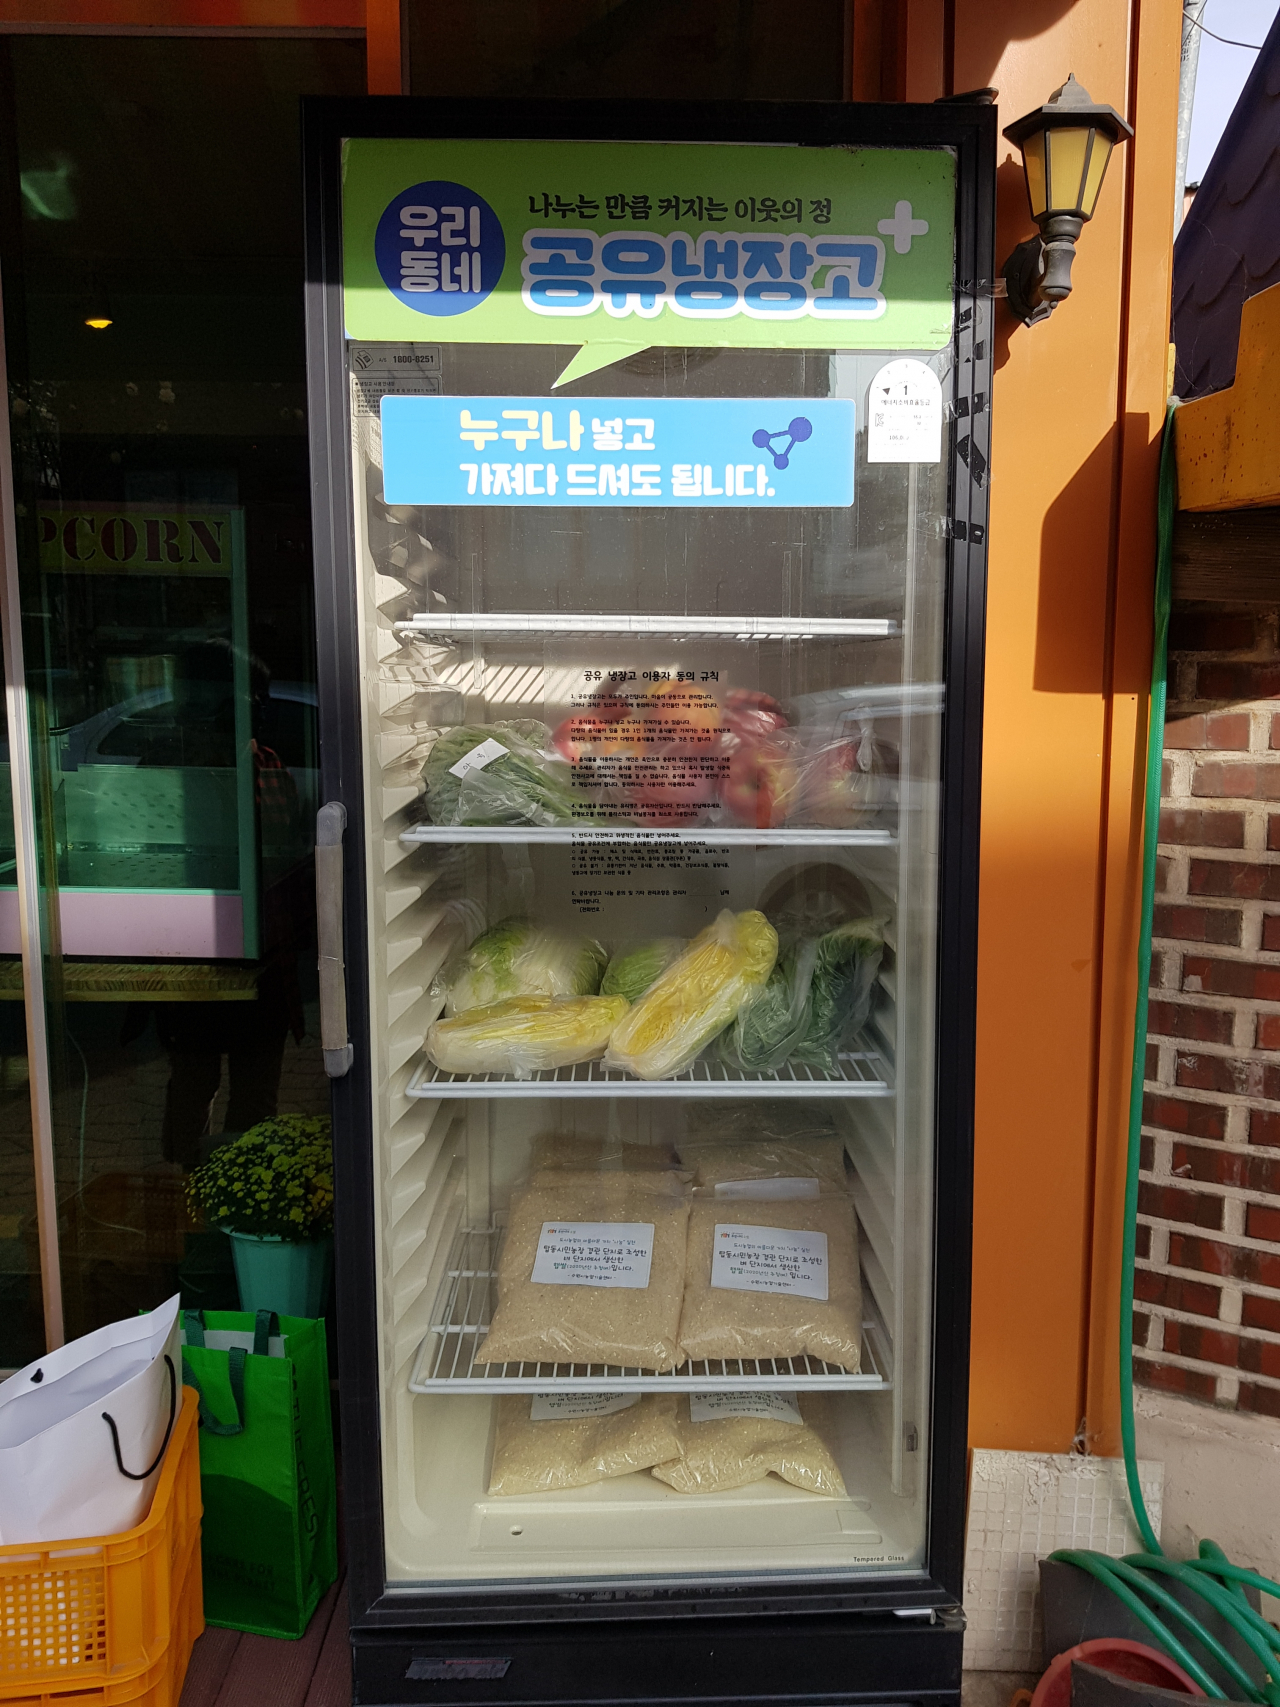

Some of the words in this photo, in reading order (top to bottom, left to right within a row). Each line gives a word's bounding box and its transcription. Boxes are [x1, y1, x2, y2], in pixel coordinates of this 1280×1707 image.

[528, 193, 601, 220] 나누는
[605, 194, 653, 222] 만큼
[657, 196, 729, 223] 커지는
[734, 197, 803, 224] 이웃의
[808, 197, 833, 225] 정
[399, 204, 481, 247] 우리
[399, 250, 482, 294] 동네
[525, 234, 882, 314] 공유냉장고
[393, 355, 434, 364] 1800-8251
[903, 384, 908, 396] 1
[458, 409, 582, 451] 누구나
[591, 416, 656, 452] 넣고
[460, 462, 559, 497] 가져다
[566, 464, 662, 497] 드셔도
[670, 463, 776, 498] 됩니다.
[584, 671, 602, 681] 공유
[608, 671, 637, 682] 냉장고
[642, 671, 671, 682] 이용자
[676, 671, 695, 682] 동의
[700, 671, 719, 682] 규칙
[602, 1247, 623, 1255] 단지로
[625, 1248, 647, 1257] 조성한
[602, 1256, 624, 1264] 생산한
[749, 1260, 777, 1269] 단지에서
[779, 1263, 800, 1271] 생산한
[778, 1254, 799, 1263] 단지로
[801, 1256, 822, 1265] 조성한
